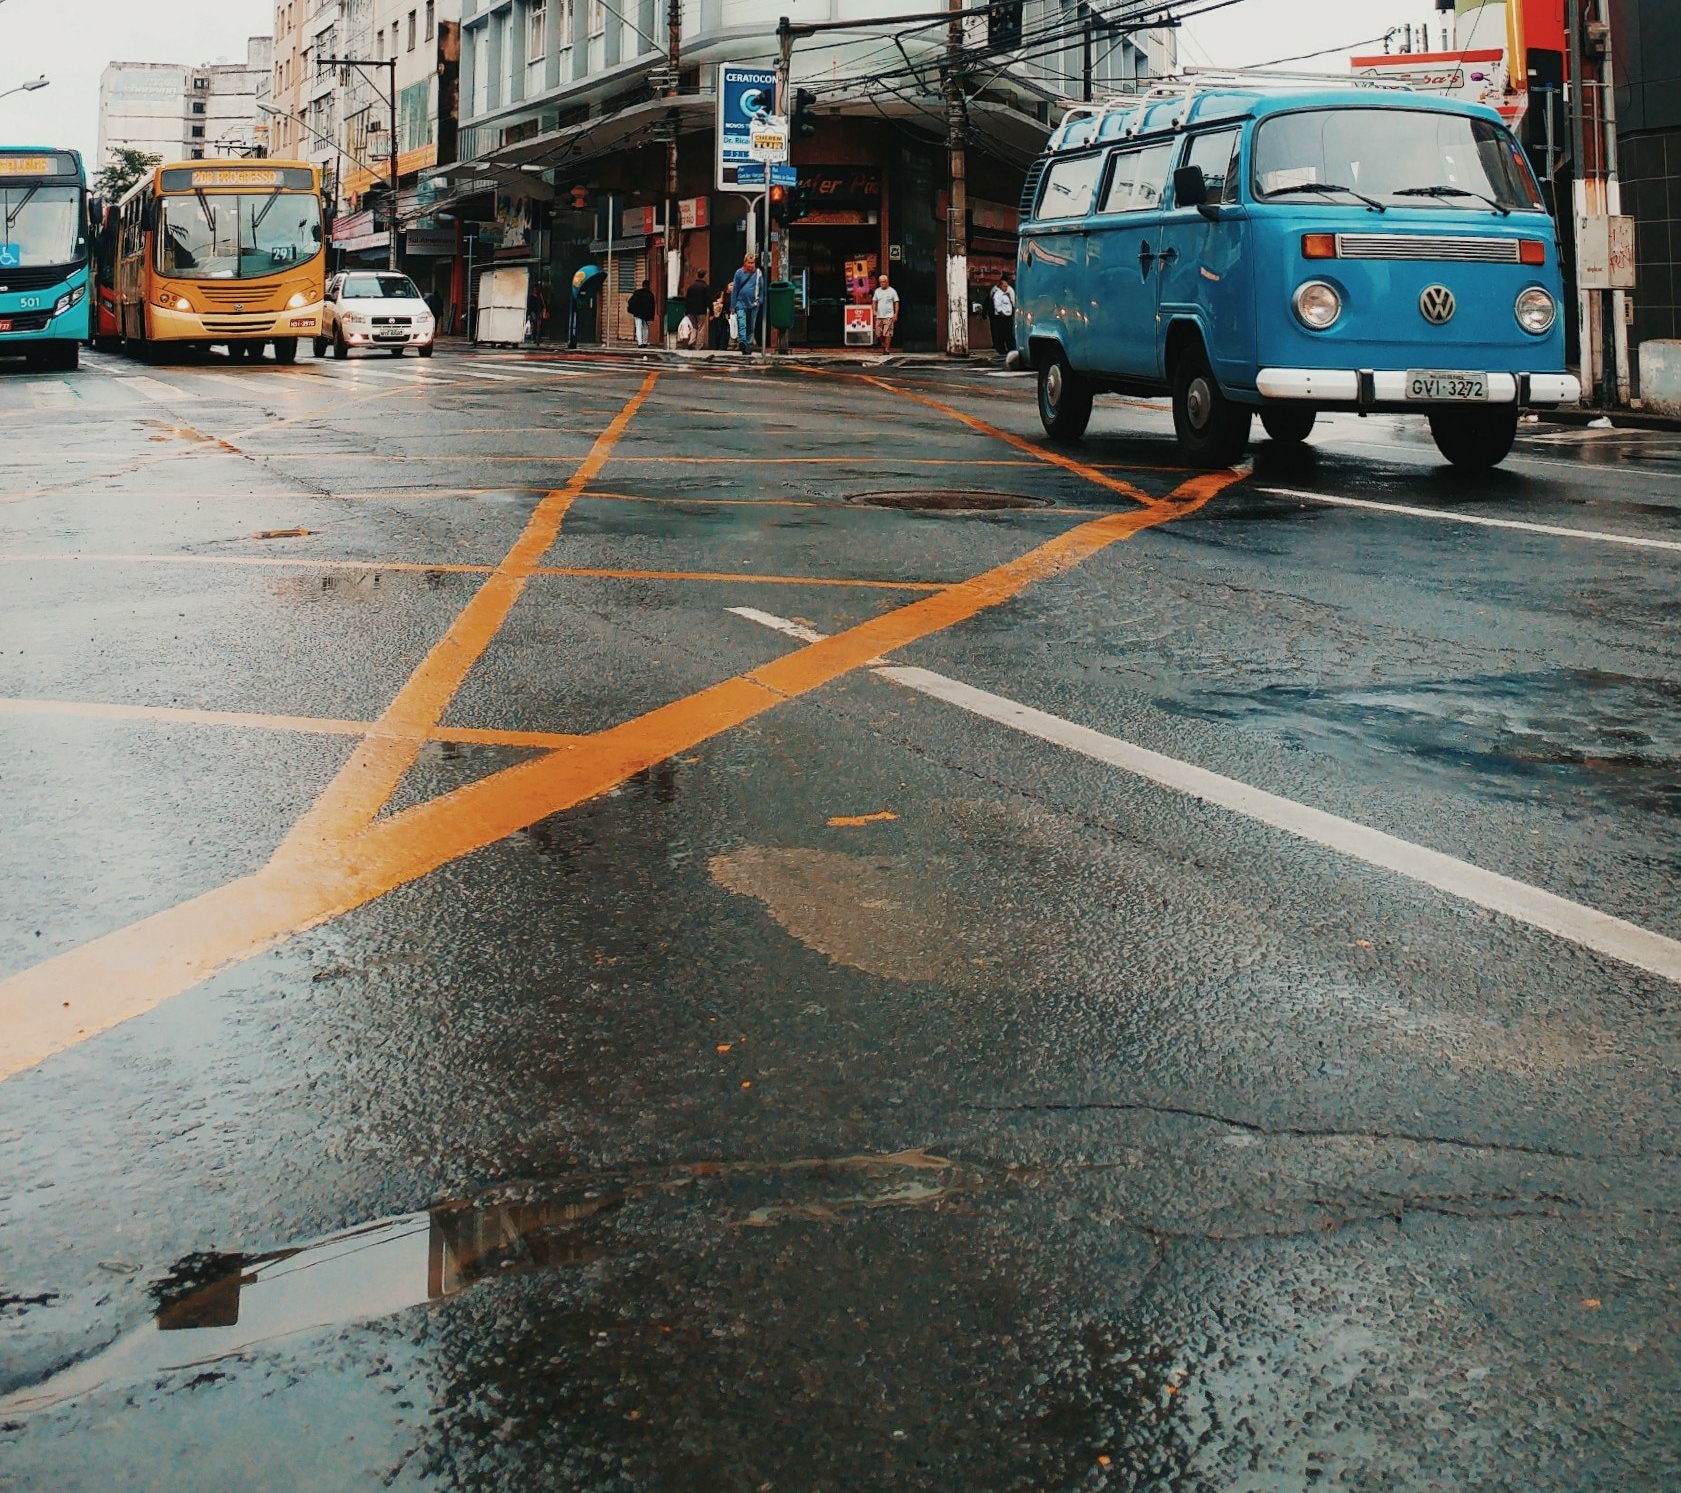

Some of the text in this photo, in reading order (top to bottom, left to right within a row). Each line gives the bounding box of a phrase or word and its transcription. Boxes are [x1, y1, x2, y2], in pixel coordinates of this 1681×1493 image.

[726, 73, 779, 84] CERATOCON
[217, 170, 277, 184] PROGRESSO
[272, 248, 293, 260] 291
[20, 297, 40, 308] 501
